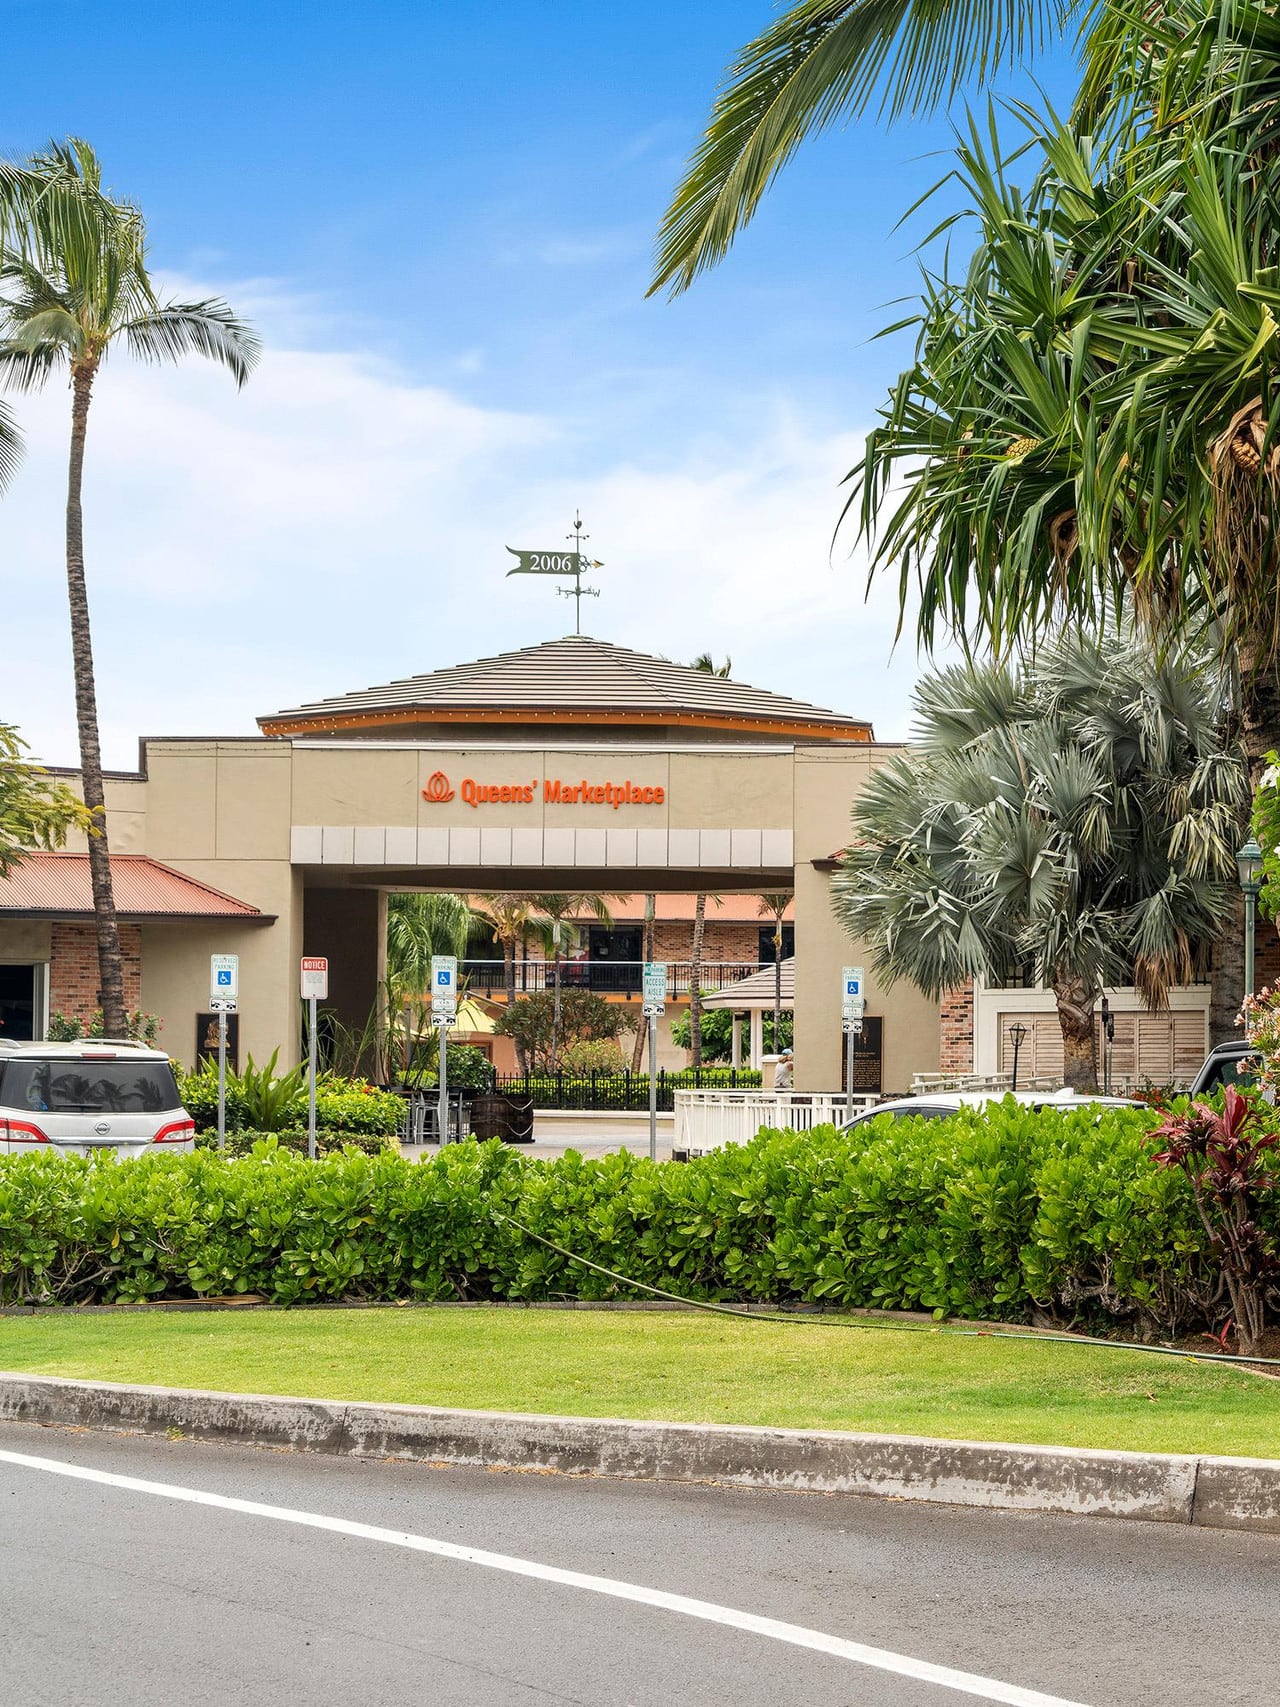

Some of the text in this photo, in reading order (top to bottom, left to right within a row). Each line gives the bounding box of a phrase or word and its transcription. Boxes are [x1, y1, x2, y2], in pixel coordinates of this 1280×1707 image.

[529, 554, 572, 571] 2006
[461, 778, 665, 810] Queens' Marketplace
[303, 960, 325, 970] NOTICE
[646, 978, 665, 986] ACCESS
[648, 988, 662, 996] AISLE
